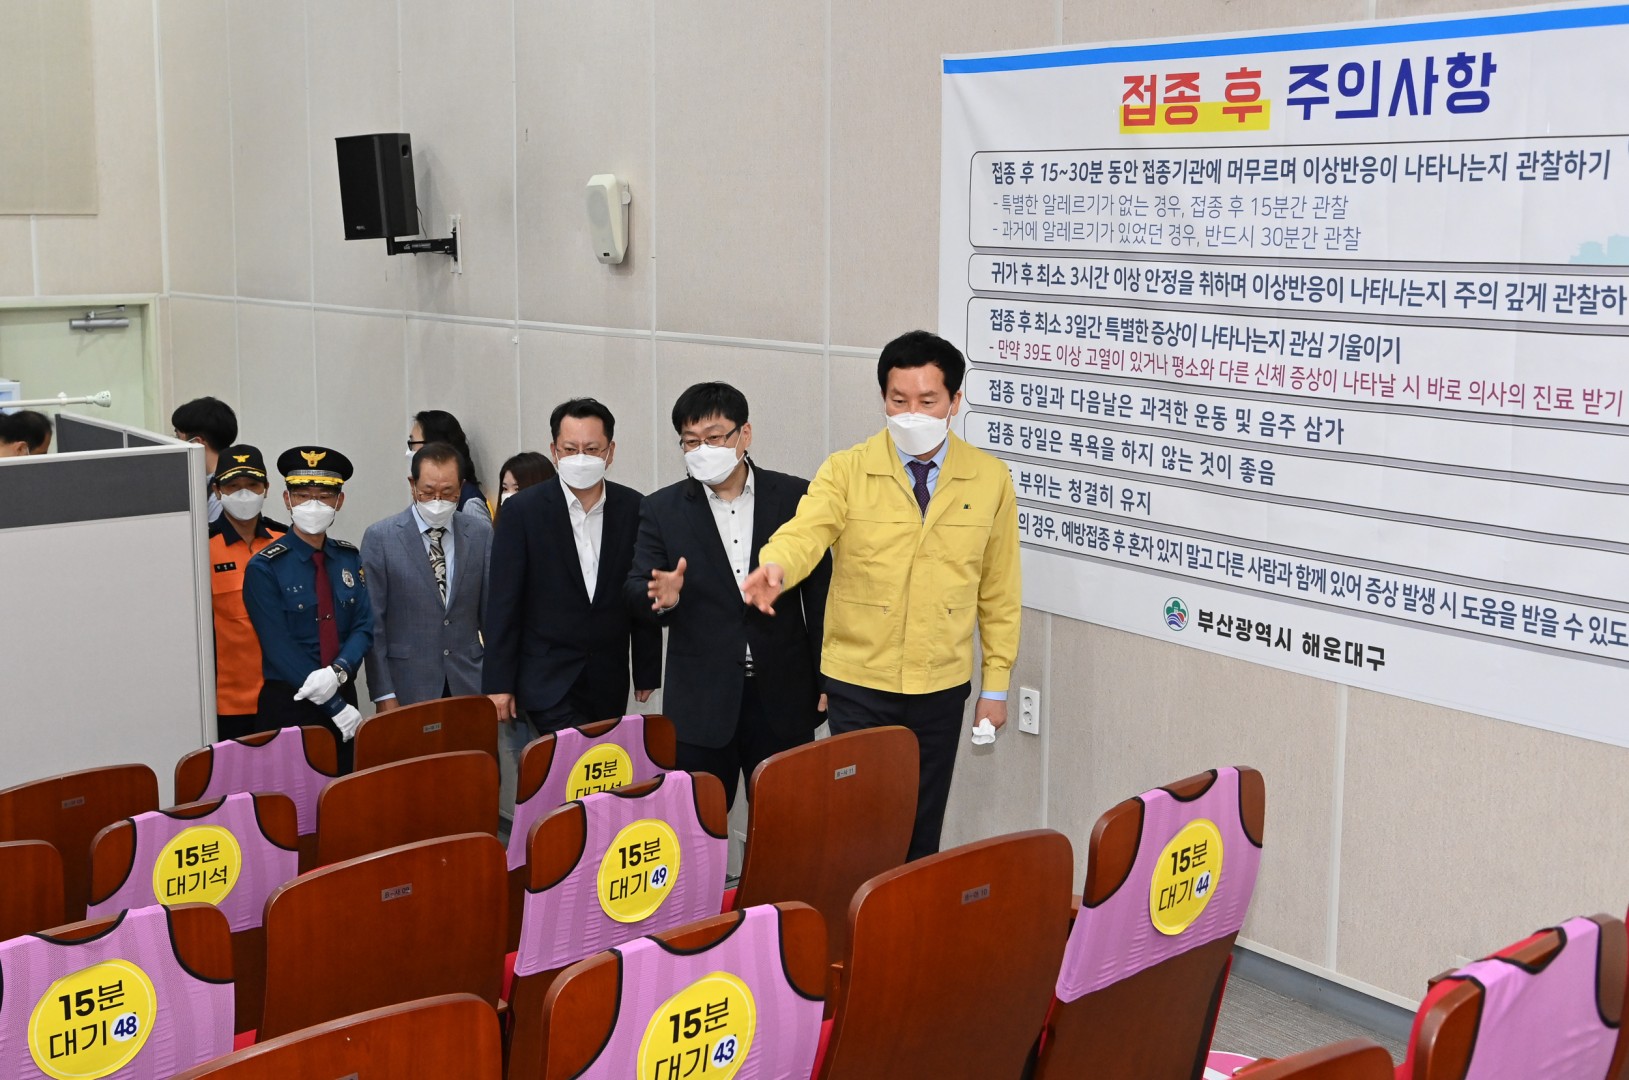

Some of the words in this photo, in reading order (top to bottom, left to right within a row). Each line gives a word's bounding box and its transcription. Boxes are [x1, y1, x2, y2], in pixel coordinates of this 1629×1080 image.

[1122, 72, 1200, 126] 접종
[1222, 67, 1262, 123] 후
[1287, 52, 1497, 120] 주의사항
[992, 161, 1015, 185] 접종
[1019, 161, 1034, 184] 후
[1040, 160, 1103, 184] 15~30분
[1108, 159, 1138, 184] 동안
[1142, 158, 1221, 184] 접종기관에
[1227, 157, 1296, 184] 머무르며
[1304, 155, 1398, 184] 이상반응이
[1405, 152, 1508, 183] 나타나는지
[1516, 150, 1611, 181] 관찰하기
[1002, 194, 1038, 215] 특별한
[1042, 194, 1114, 216] 알레르기가
[1118, 196, 1149, 217] 없는
[1154, 195, 1185, 218] 경우,
[1190, 196, 1223, 218] 접종
[1228, 196, 1245, 218] 후
[1250, 196, 1307, 220] 15분간
[1312, 196, 1349, 220] 관찰
[1002, 220, 1038, 241] 과거에
[1042, 221, 1114, 243] 알레르기가
[1118, 223, 1163, 246] 있었던
[1169, 225, 1200, 247] 경우,
[1205, 224, 1254, 248] 반드시
[1261, 226, 1318, 250] 30분간
[1323, 226, 1361, 251] 관찰
[991, 262, 1018, 285] 귀가
[1021, 263, 1034, 285] 후
[1036, 264, 1066, 287] 최소
[1070, 266, 1110, 290] 3시간
[1113, 267, 1141, 292] 이상
[1145, 268, 1194, 295] 안정을
[1199, 270, 1246, 299] 취하며
[1252, 272, 1344, 303] 이상반응이
[1351, 276, 1446, 308] 나타나는지
[1453, 280, 1498, 310] 주의
[1505, 282, 1546, 312] 깊게
[1553, 284, 1627, 315] 관찰하
[990, 308, 1015, 334] 접종
[1018, 309, 1032, 333] 후
[1035, 311, 1061, 335] 최소
[1065, 314, 1102, 339] 3일간
[1104, 316, 1148, 343] 특별한
[1151, 319, 1197, 349] 증상이
[1201, 323, 1285, 355] 나타나는지
[1289, 329, 1324, 358] 관심
[1327, 333, 1401, 364] 기울이기
[998, 339, 1020, 360] 만약
[1023, 343, 1051, 362] 39도
[1056, 344, 1081, 366] 이상
[1085, 347, 1124, 370] 고열이
[1130, 350, 1167, 375] 있거나
[1172, 354, 1214, 380] 평소와
[1219, 359, 1249, 384] 다른
[1254, 362, 1285, 387] 신체
[1289, 365, 1338, 393] 증상이
[1343, 370, 1396, 398] 나타날
[1402, 375, 1420, 399] 시
[1427, 376, 1462, 401] 바로
[1467, 380, 1525, 409] 의사의
[1533, 386, 1574, 412] 진료
[1582, 388, 1623, 417] 받기
[989, 379, 1014, 403] 접종
[1020, 382, 1064, 410] 당일과
[1071, 389, 1133, 418] 다음날은
[1140, 397, 1188, 425] 과격한
[1194, 403, 1227, 431] 운동
[1235, 408, 1251, 435] 및
[1259, 411, 1296, 439] 음주
[1304, 416, 1344, 445] 삼가
[987, 421, 1014, 446] 접종
[1020, 426, 1063, 453] 당일은
[1069, 432, 1115, 461] 목욕을
[1122, 439, 1153, 466] 하지
[1161, 445, 1193, 472] 않는
[1200, 451, 1231, 479] 것이
[1239, 457, 1276, 486] 좋음
[1019, 471, 1062, 499] 부위는
[1068, 478, 1113, 508] 청결히
[1120, 487, 1151, 515] 유지
[1032, 515, 1058, 541] 경우,
[1061, 520, 1110, 551] 예방접종
[1112, 530, 1126, 553] 후
[1128, 532, 1154, 559] 혼자
[1157, 537, 1183, 565] 있지
[1187, 544, 1213, 570] 말고
[1217, 550, 1245, 578] 다른
[1248, 555, 1292, 587] 사람과
[1296, 563, 1326, 594] 함께
[1330, 571, 1362, 601] 있어
[1365, 576, 1399, 608] 증상
[1403, 583, 1436, 616] 발생
[1440, 591, 1457, 619] 시
[1461, 595, 1518, 630] 도움을
[1522, 604, 1559, 638] 받을
[1564, 613, 1584, 641] 수
[1198, 609, 1292, 651] 부산광역시
[1302, 632, 1386, 671] 해운대구
[584, 759, 617, 781] 15분
[174, 841, 220, 869] 15분
[618, 837, 661, 869] 15분
[1171, 840, 1207, 876] 15분
[166, 865, 228, 897] 대기석
[609, 870, 648, 901] 대기
[651, 866, 667, 885] 49
[1158, 877, 1194, 912] 대기
[1195, 874, 1210, 893] 44
[58, 979, 125, 1021] 15분
[669, 997, 729, 1044] 15분
[49, 1020, 107, 1059] 대기
[114, 1015, 137, 1036] 48
[713, 1038, 735, 1063] 43
